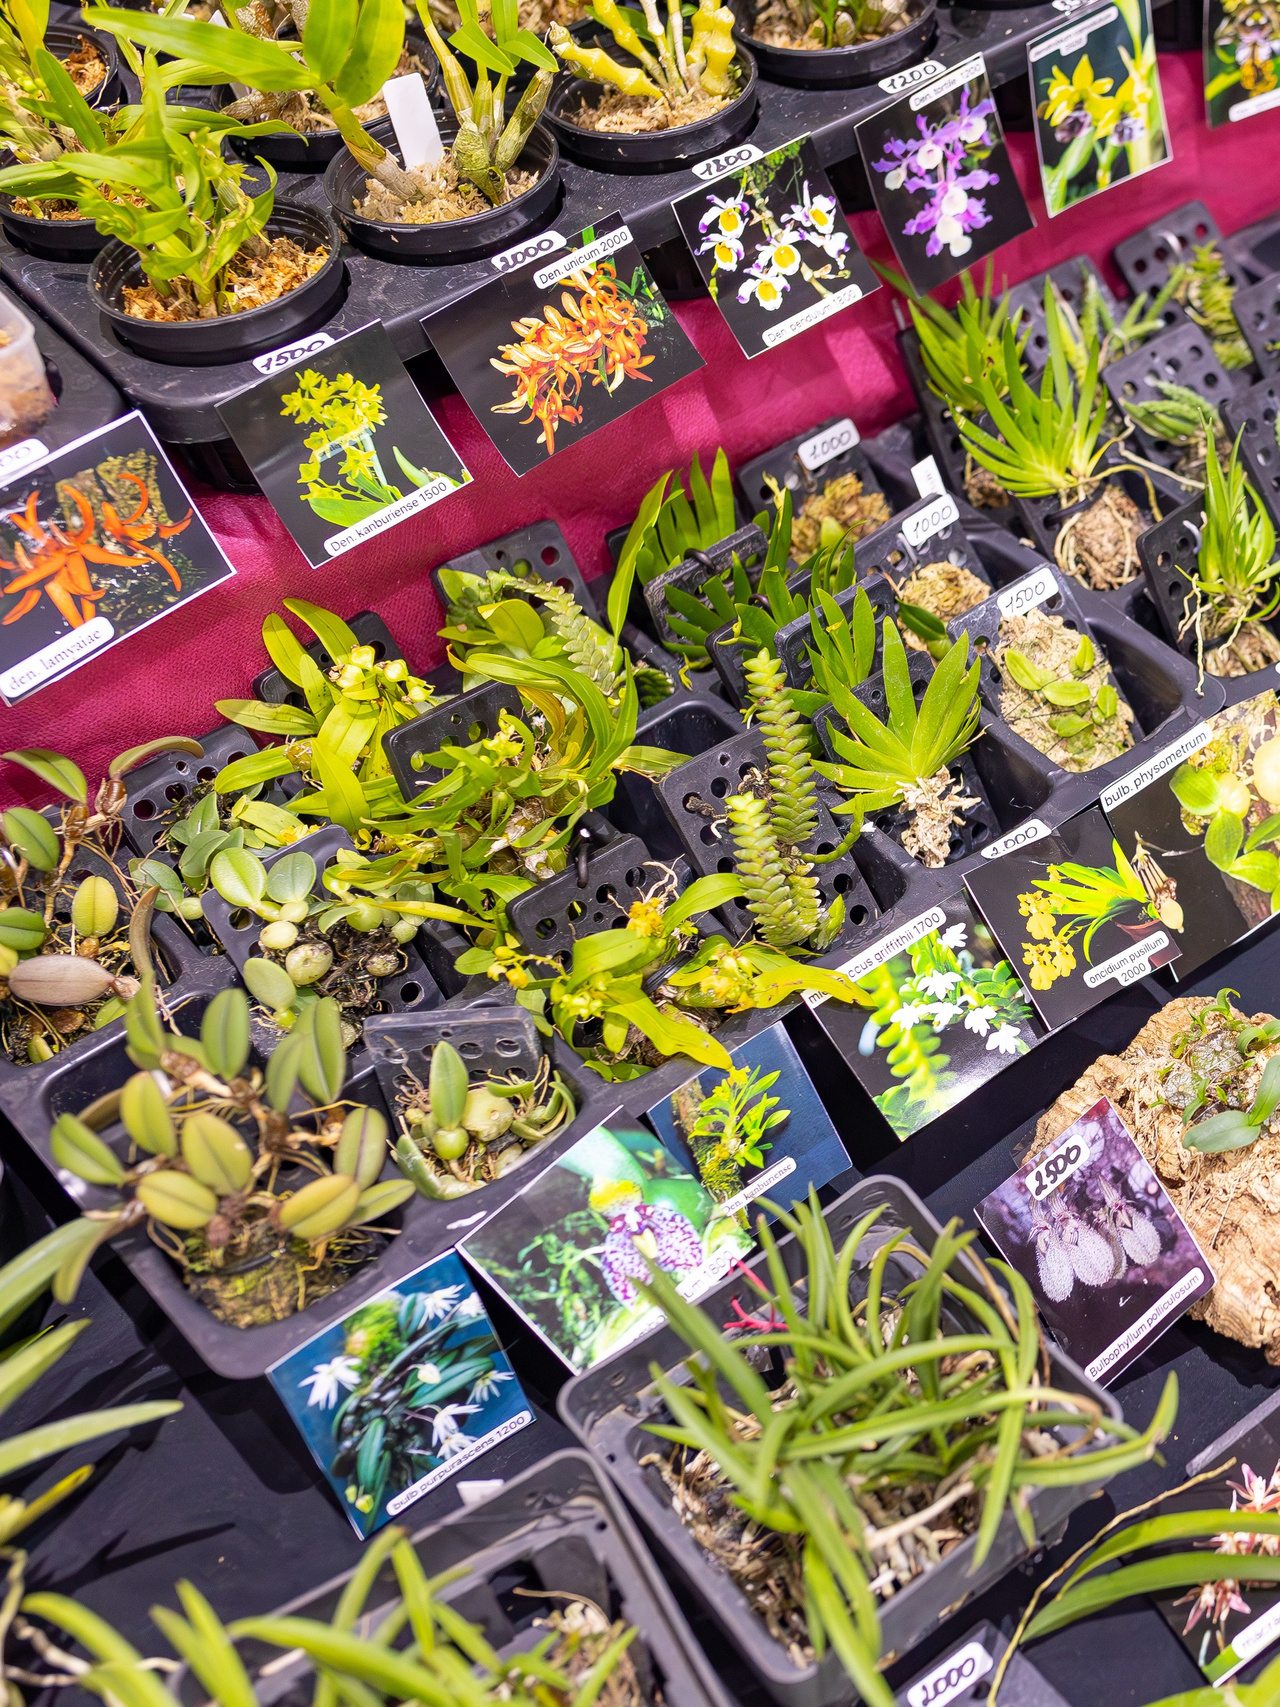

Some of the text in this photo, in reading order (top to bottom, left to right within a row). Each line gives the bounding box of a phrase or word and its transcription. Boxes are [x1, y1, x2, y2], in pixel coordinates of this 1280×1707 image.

[887, 64, 937, 89] 1200
[500, 238, 554, 272] 2000
[538, 231, 628, 284] Den. unicum 2000
[789, 303, 833, 333] pendulum
[833, 290, 857, 308] 1800
[260, 340, 326, 372] 1500
[330, 481, 447, 552] Den. kanburiense 1500
[912, 505, 953, 540] 1000
[1005, 581, 1046, 613] 1500
[1104, 732, 1207, 807] bulb. physometrum
[874, 929, 913, 963] griffithii
[912, 912, 941, 941] 1700
[1089, 936, 1166, 984] oncidium pusillum
[1120, 962, 1147, 983] 2000
[743, 1163, 793, 1201] kanburiense
[1034, 1144, 1082, 1197] 2500
[1089, 1274, 1200, 1378] Bulbophyllum polliculosum
[418, 1436, 495, 1493] purpurascens
[495, 1416, 526, 1438] 1200
[922, 1657, 975, 1707] 2000
